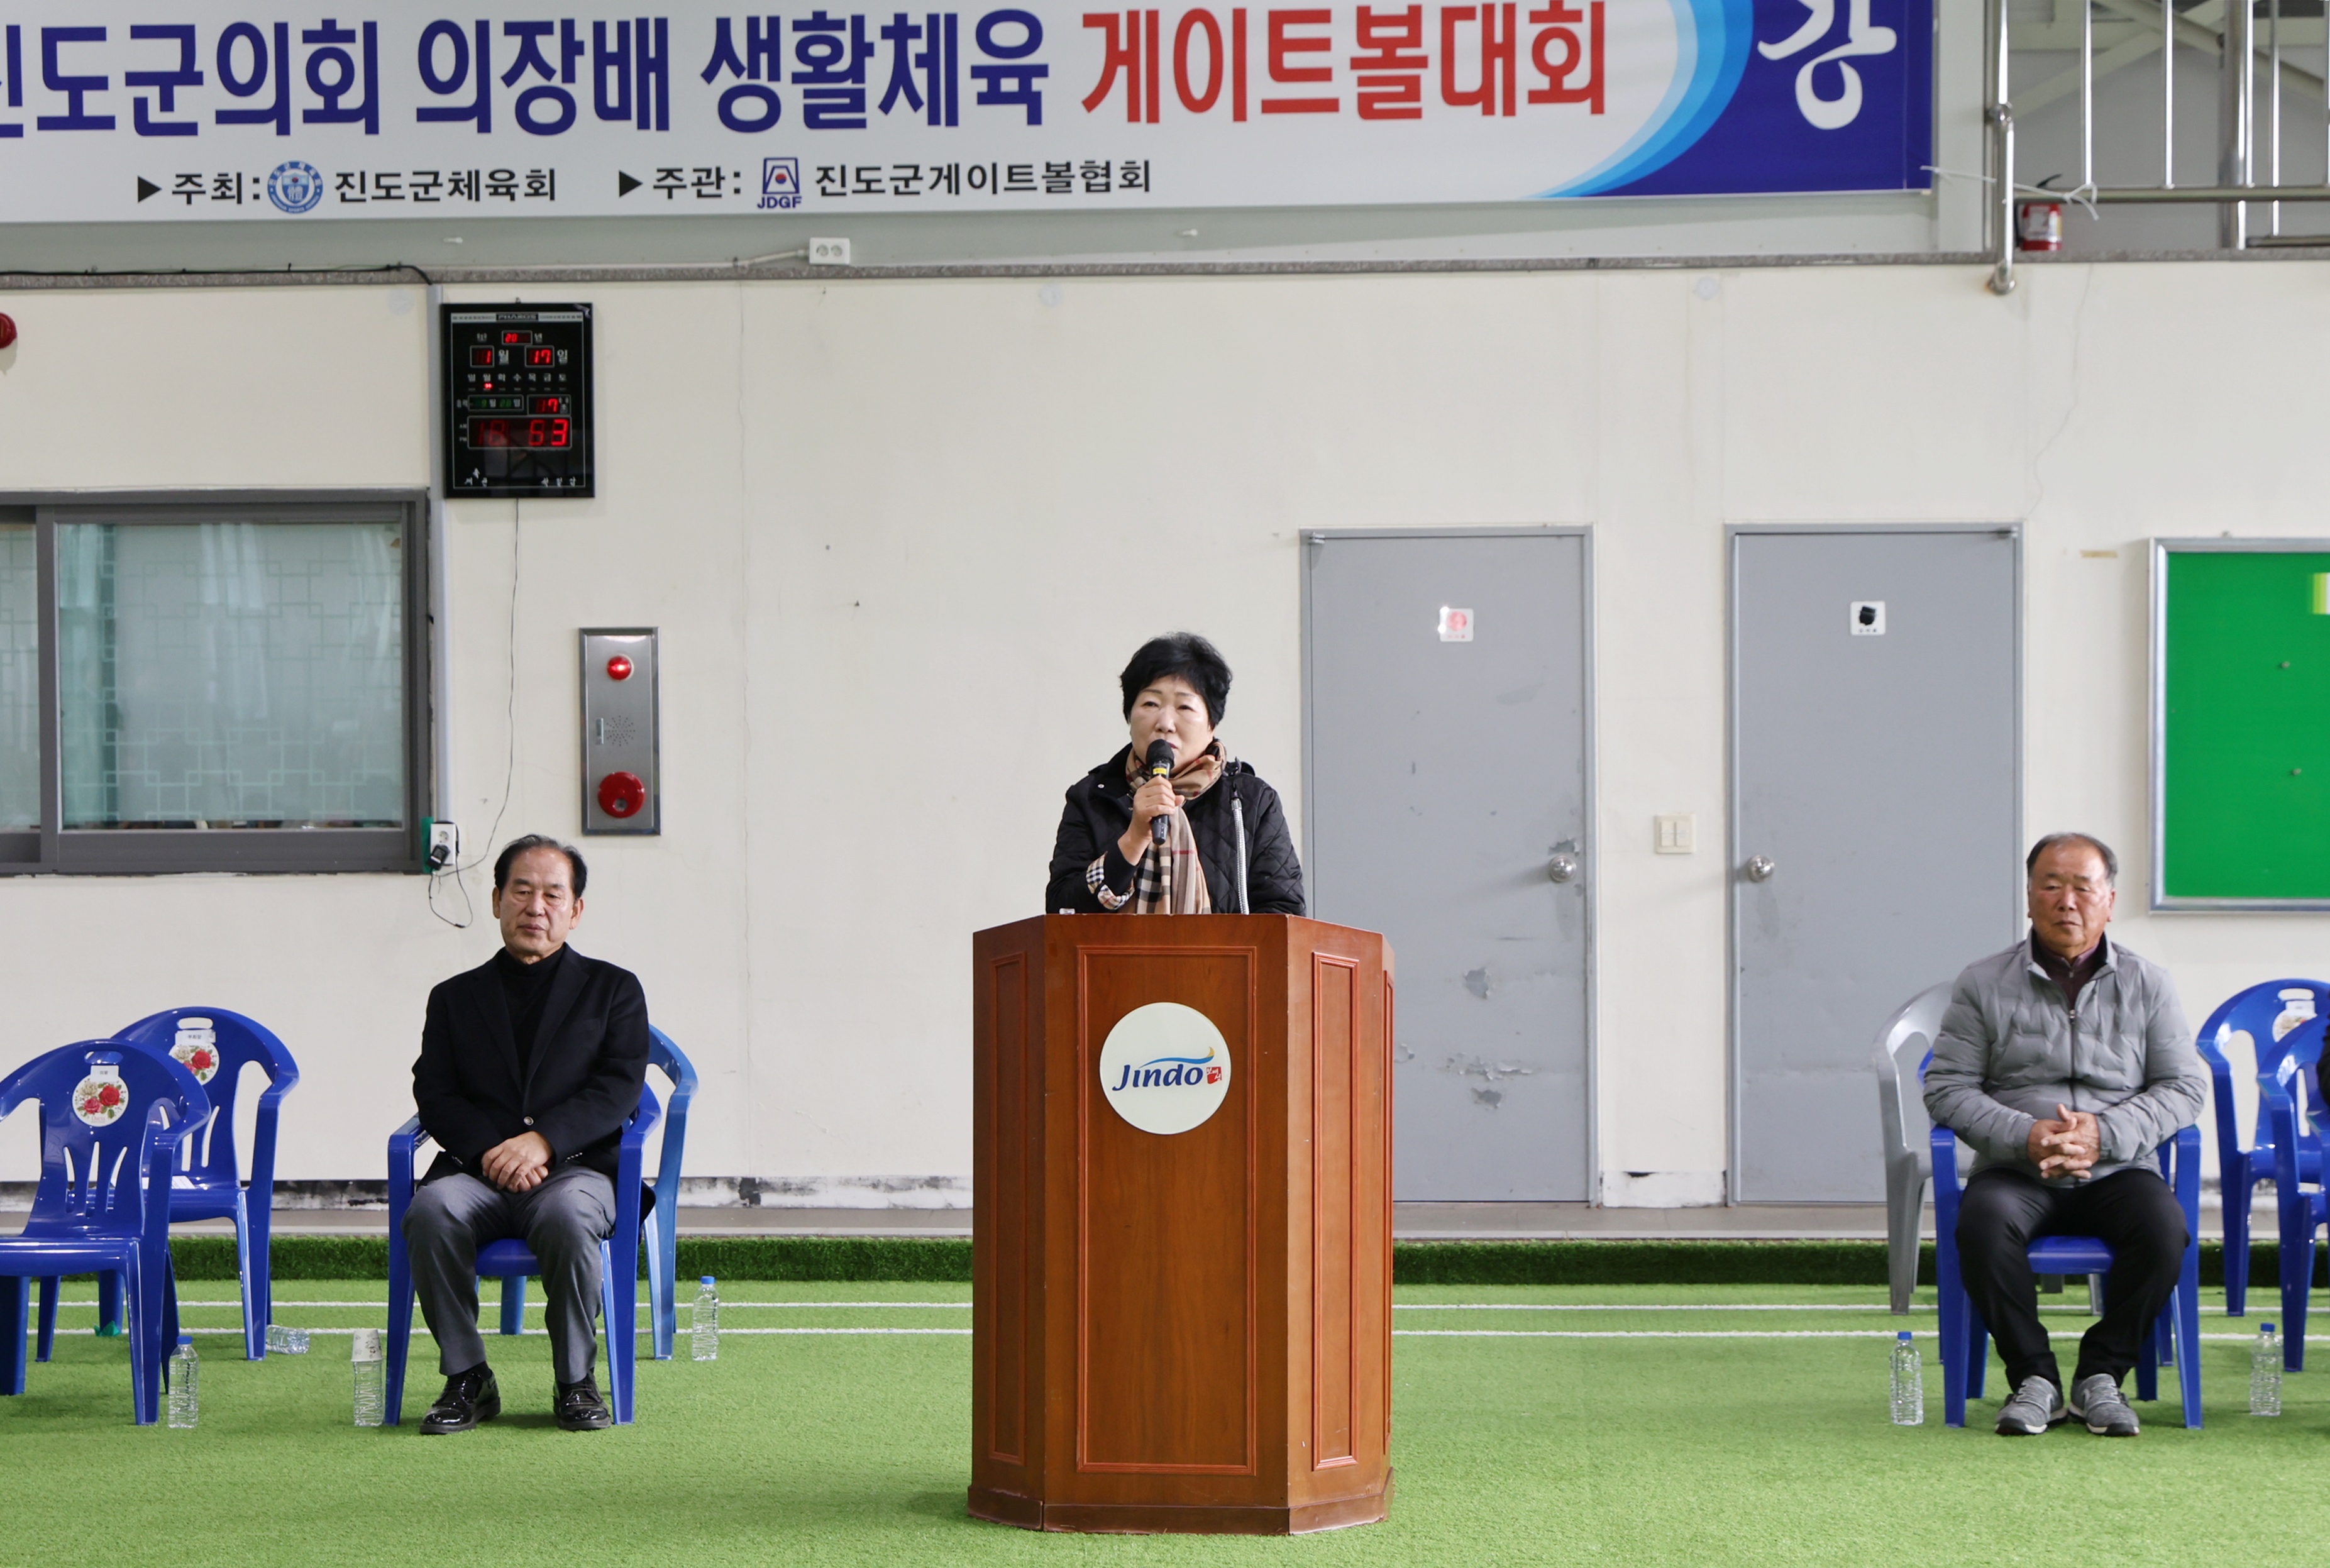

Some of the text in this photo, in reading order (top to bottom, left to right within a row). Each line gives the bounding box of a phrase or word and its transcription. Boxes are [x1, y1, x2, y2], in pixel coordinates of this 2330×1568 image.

[417, 18, 670, 136] 의장배
[701, 9, 1049, 133] 생활체육
[1082, 0, 1605, 124] 게이트볼대회
[335, 168, 556, 204] 진도군체육회
[815, 160, 1151, 197] 진도군게이트볼협회
[757, 196, 802, 209] JDGF
[1112, 1064, 1204, 1091] Jindo
